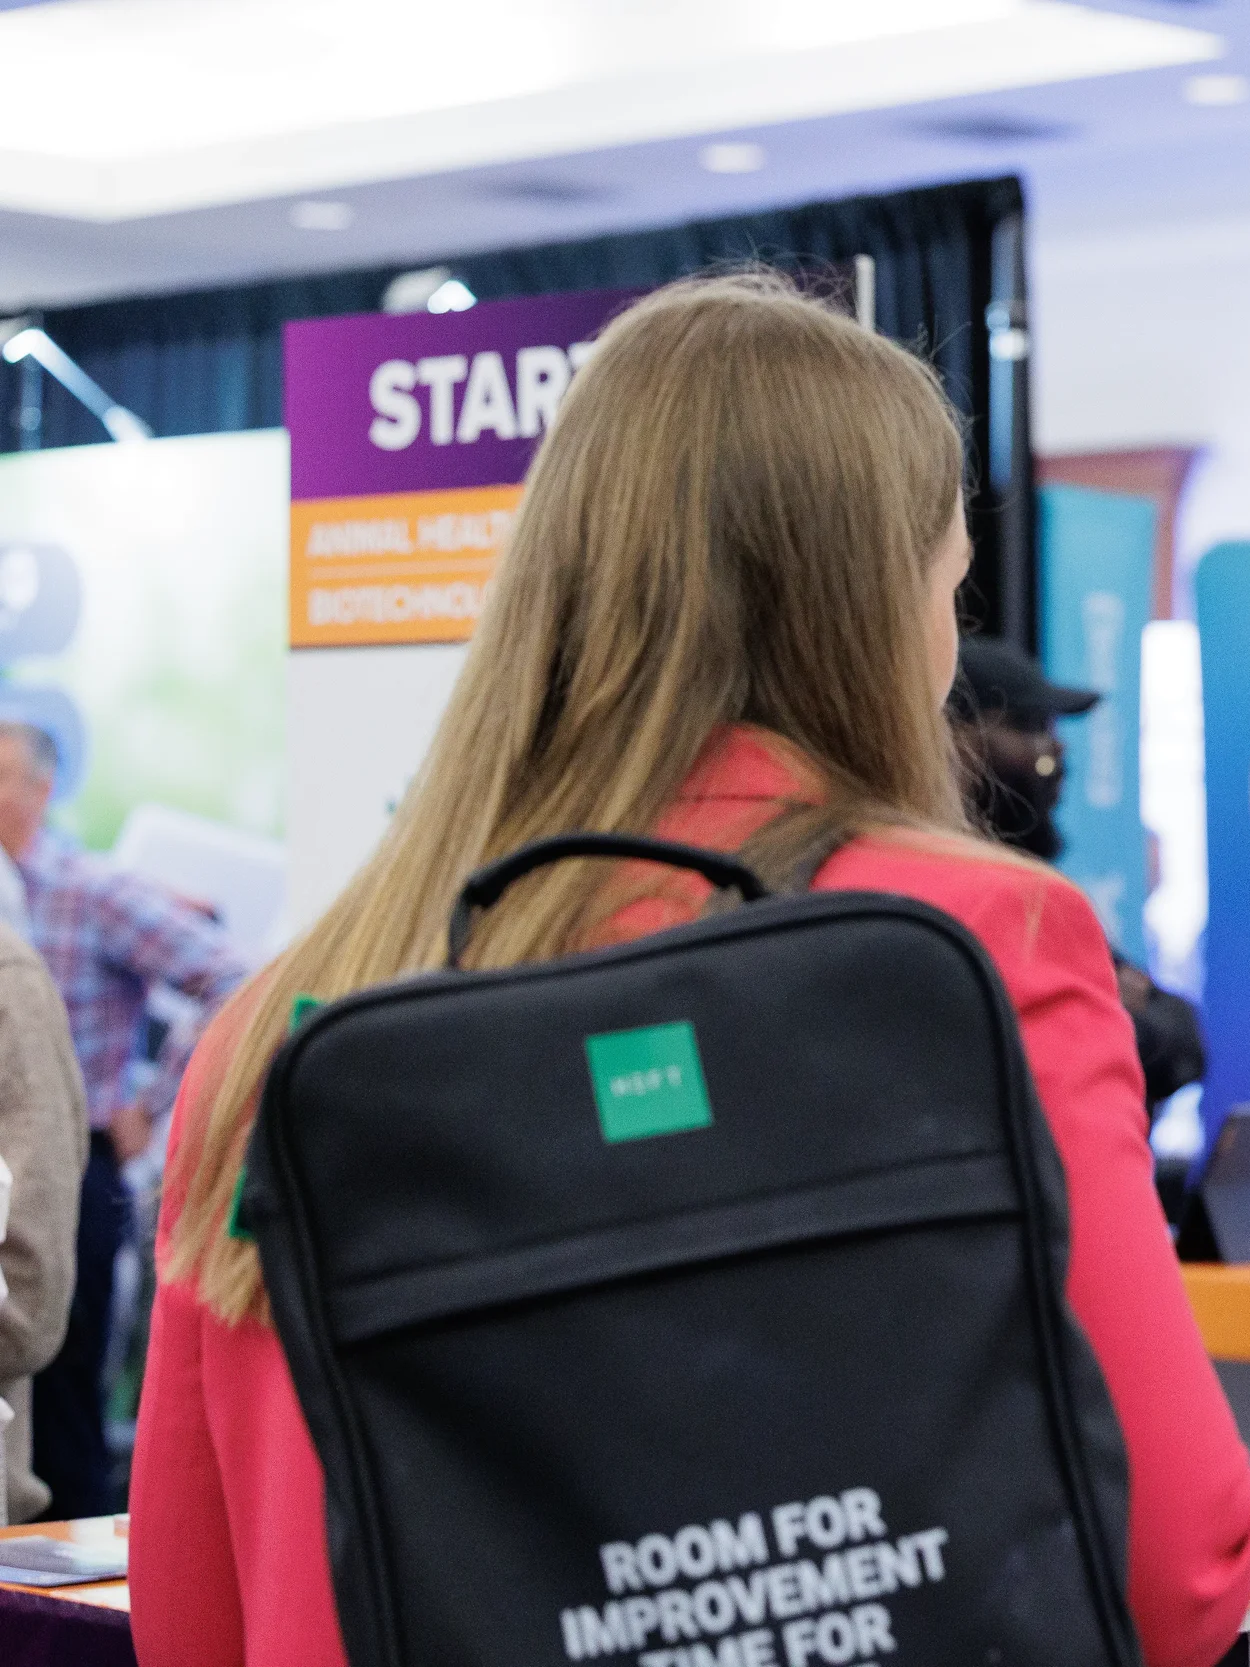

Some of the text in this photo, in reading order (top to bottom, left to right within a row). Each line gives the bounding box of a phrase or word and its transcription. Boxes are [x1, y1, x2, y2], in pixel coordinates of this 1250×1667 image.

[306, 516, 413, 559] ANIMAL
[601, 1486, 887, 1594] ROOM FOR
[560, 1527, 948, 1661] IMPROVEMENT
[781, 1602, 897, 1667] FOR
